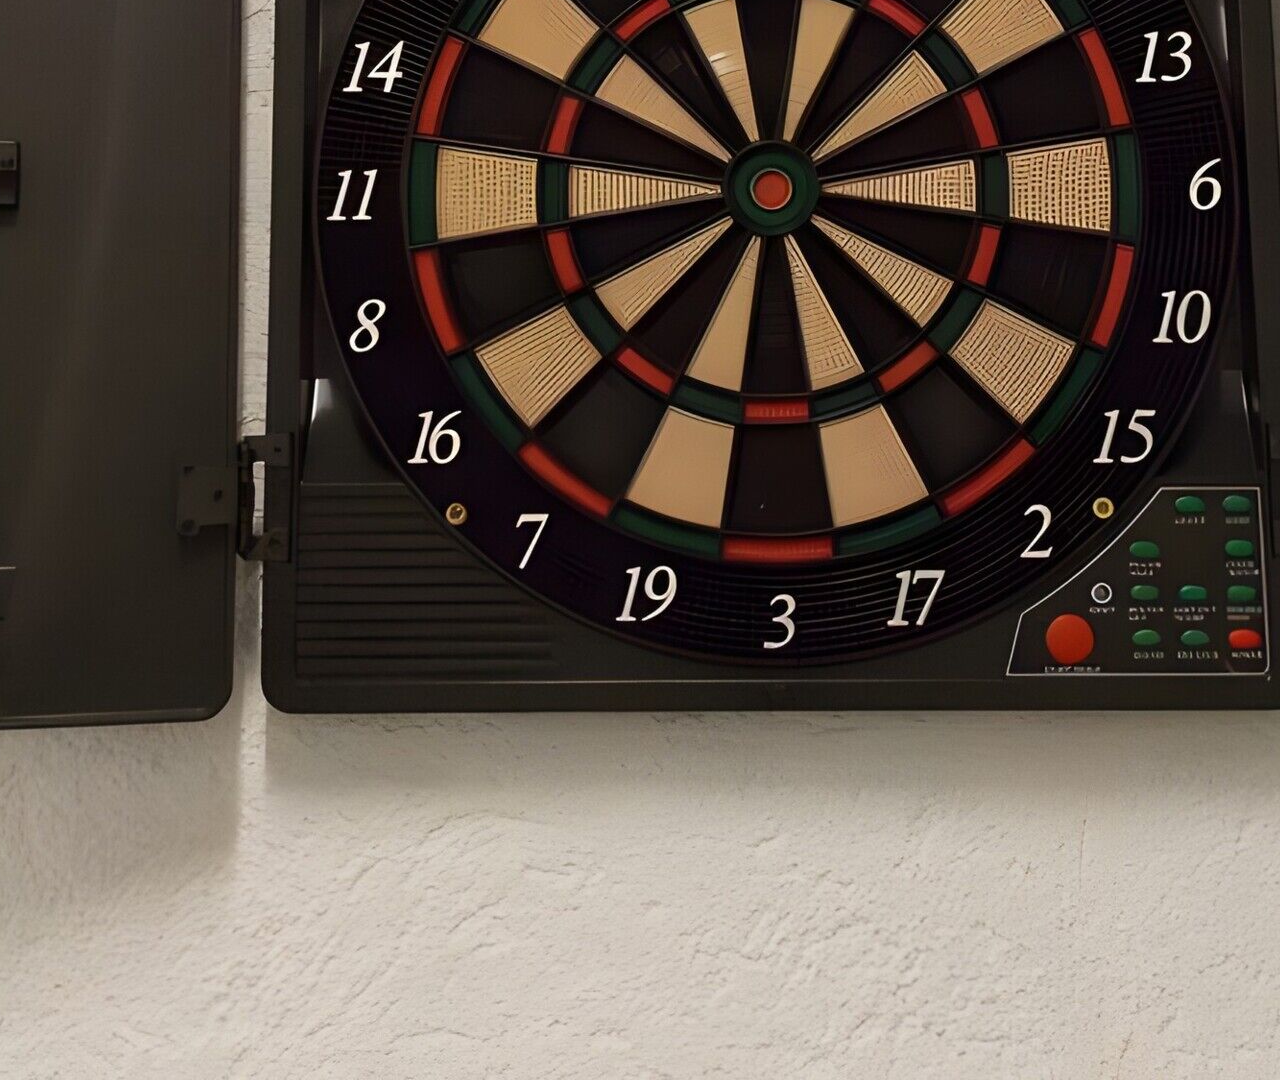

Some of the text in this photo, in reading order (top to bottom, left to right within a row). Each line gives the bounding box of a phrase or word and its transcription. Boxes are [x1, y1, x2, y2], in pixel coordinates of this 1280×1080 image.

[343, 41, 404, 92] 14
[1136, 32, 1191, 82] 13
[327, 169, 377, 220] 11
[1190, 158, 1221, 210] 6
[349, 299, 386, 352] 8
[1153, 290, 1210, 343] 10
[408, 411, 461, 464] 16
[1093, 409, 1155, 463] 15
[516, 514, 548, 569] 7
[1020, 505, 1053, 557] 2
[616, 566, 676, 621] 19
[887, 570, 945, 626] 17
[764, 594, 795, 648] 3
